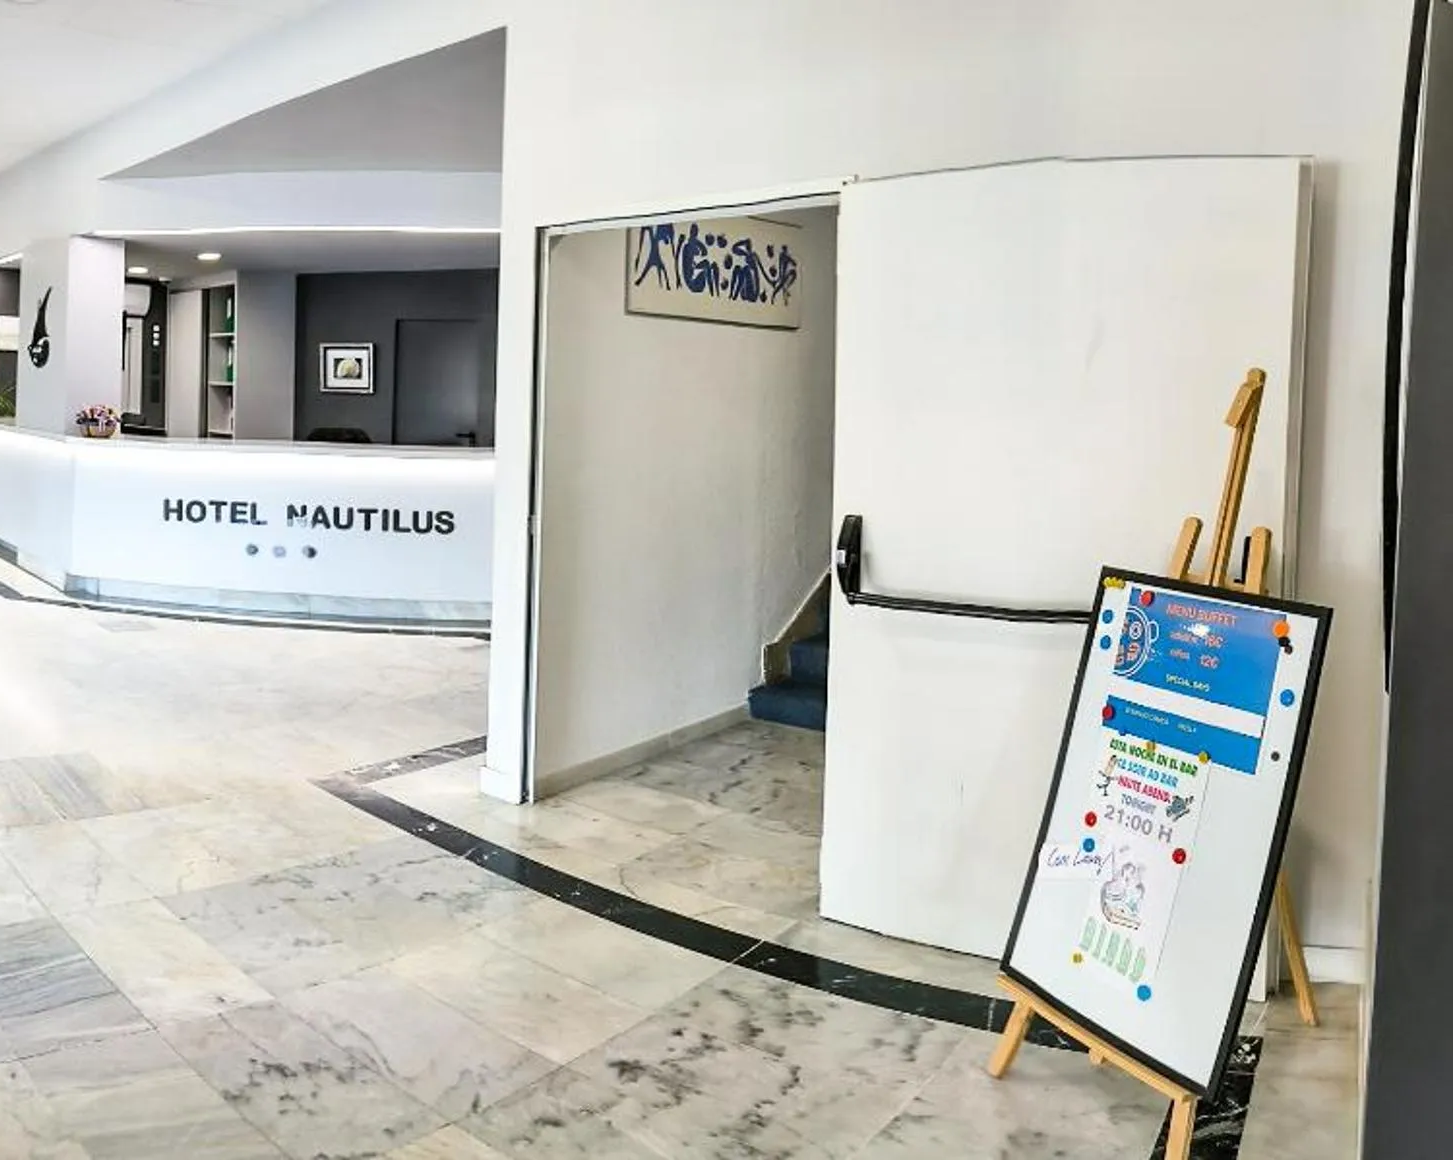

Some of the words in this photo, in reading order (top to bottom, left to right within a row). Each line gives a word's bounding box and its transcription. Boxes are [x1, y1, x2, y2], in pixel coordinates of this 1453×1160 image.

[163, 498, 267, 526] HOTEL
[286, 503, 455, 534] NAUTILUS
[1197, 606, 1238, 627] BUFFET
[1179, 761, 1198, 776] BAR
[1104, 804, 1154, 836] 21:00
[1158, 824, 1173, 844] H
